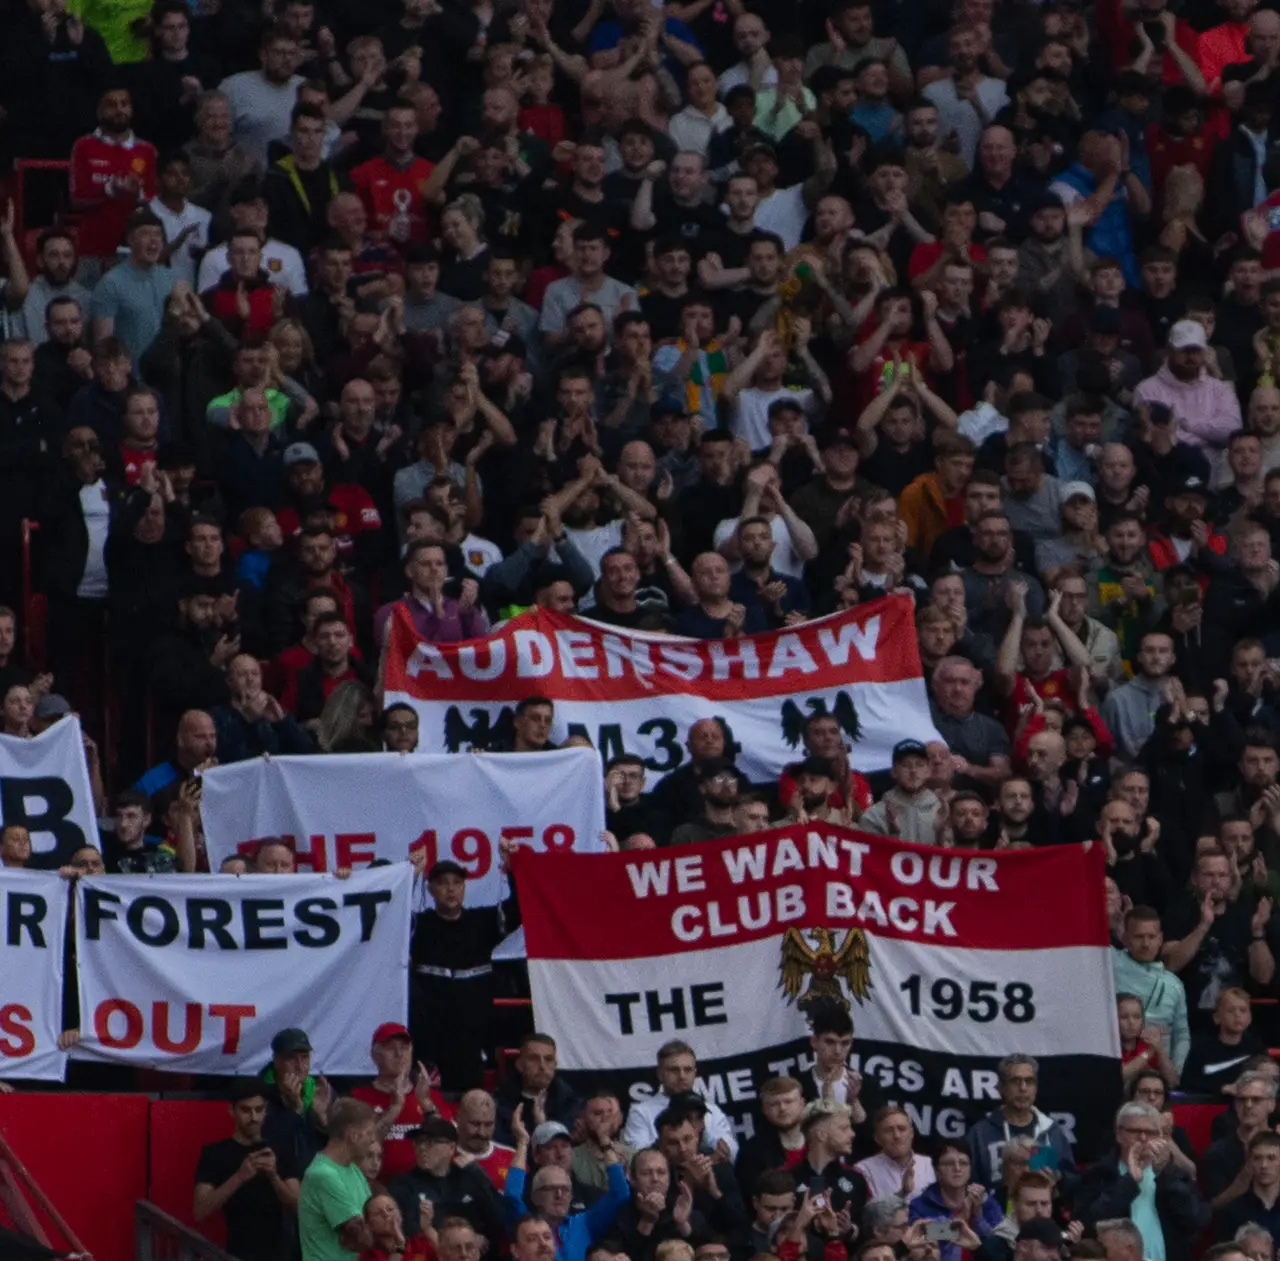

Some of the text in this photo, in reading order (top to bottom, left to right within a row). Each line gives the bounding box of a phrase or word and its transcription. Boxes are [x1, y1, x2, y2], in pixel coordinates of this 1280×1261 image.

[406, 615, 881, 683] AUDENSHAW
[625, 831, 1000, 899] WE WANT OUR
[83, 889, 393, 951] FOREST
[671, 882, 959, 942] CLUB BACK
[94, 998, 257, 1056] OUT
[605, 973, 1037, 1037] THE 1958
[628, 1068, 757, 1107] SME
